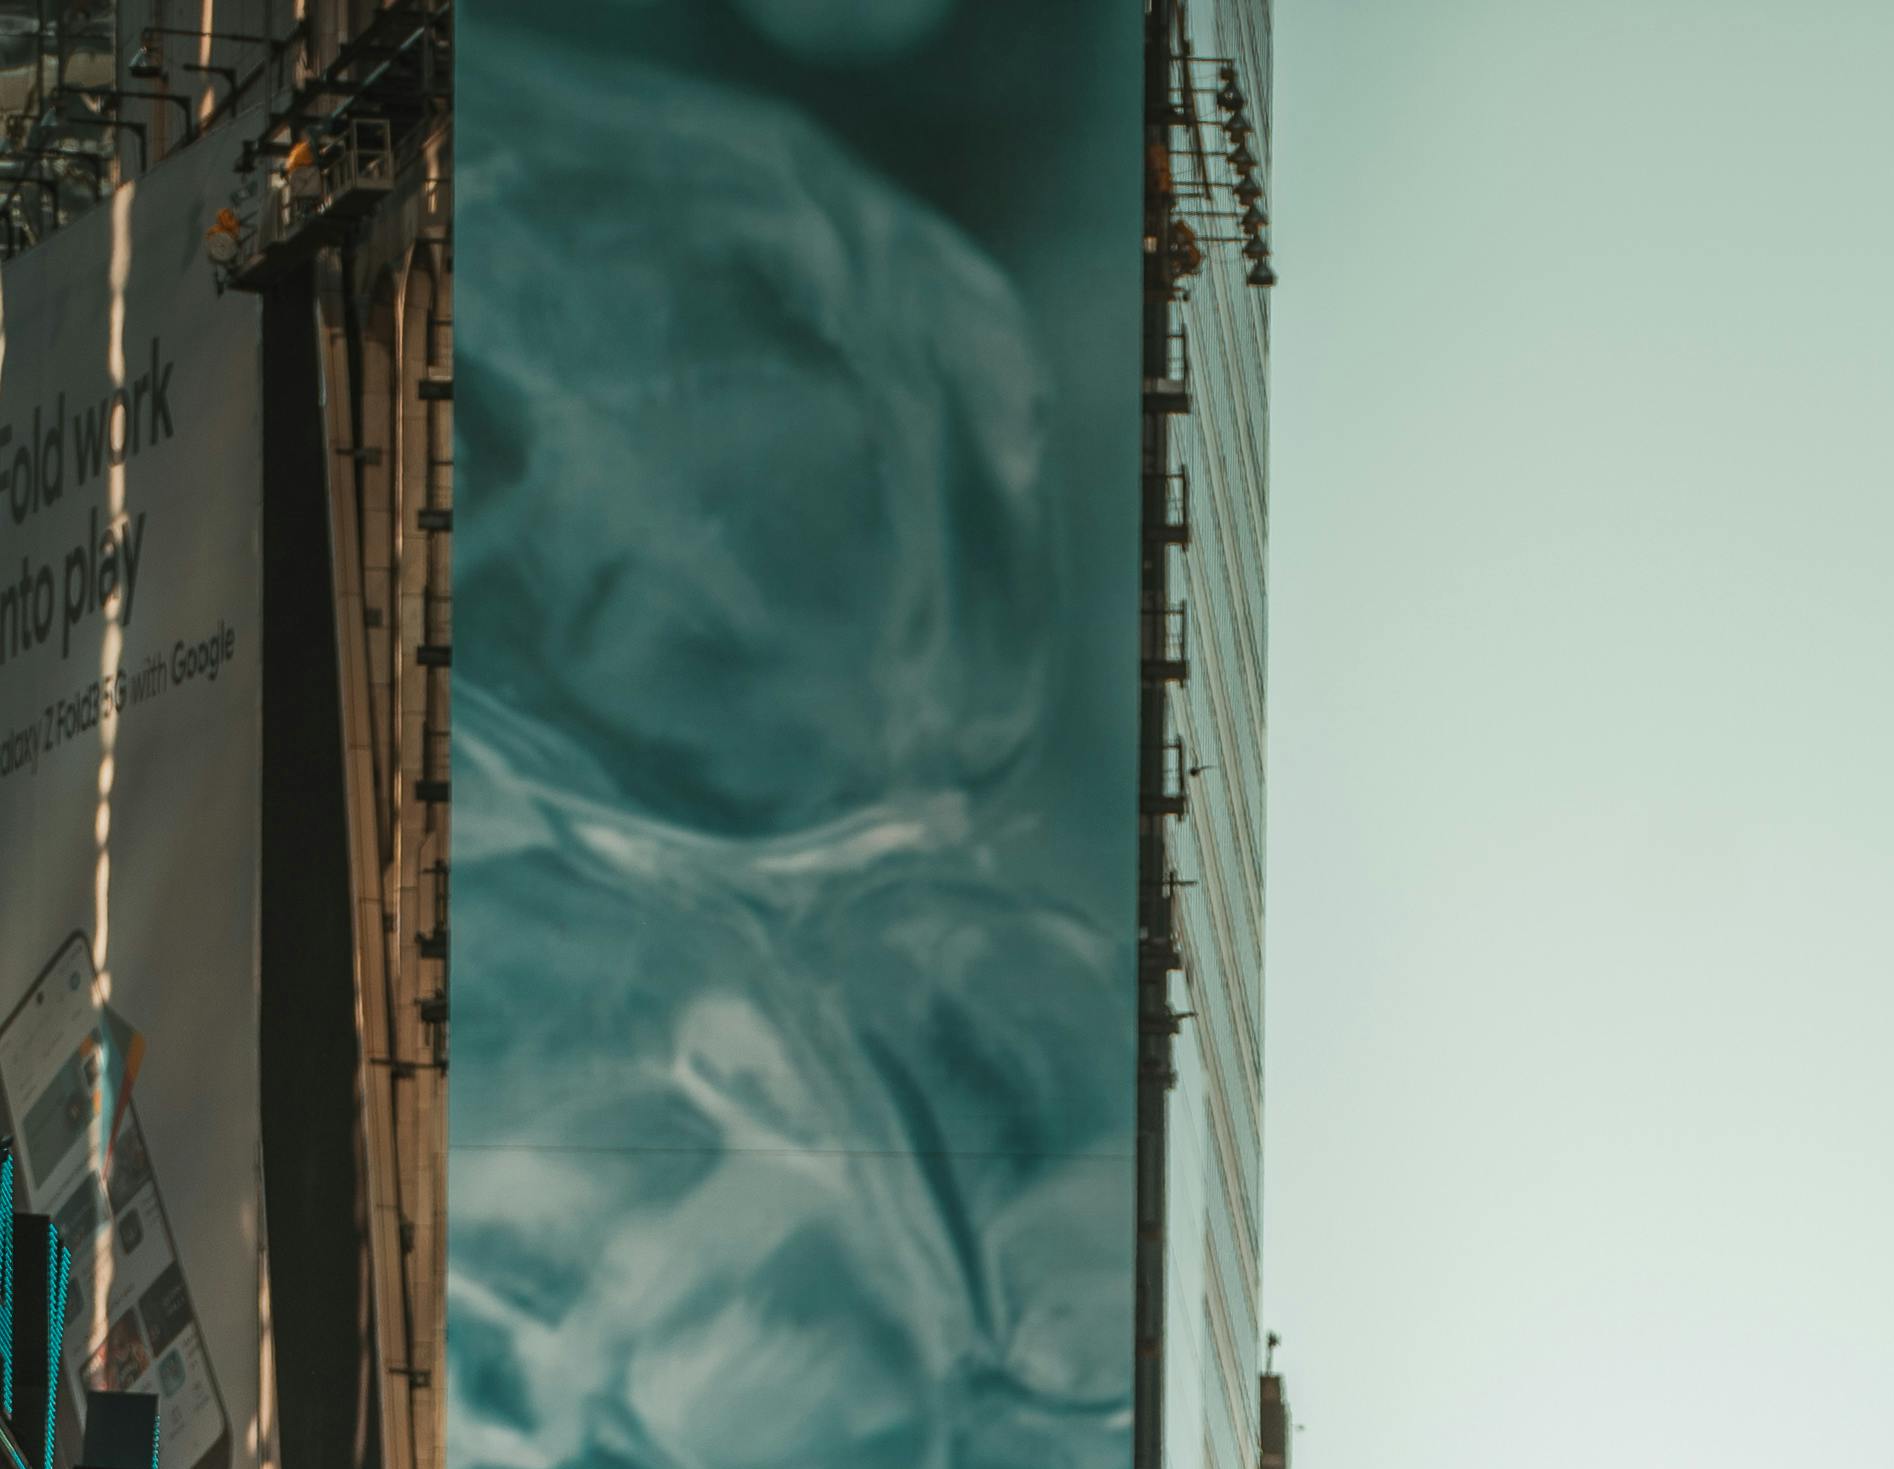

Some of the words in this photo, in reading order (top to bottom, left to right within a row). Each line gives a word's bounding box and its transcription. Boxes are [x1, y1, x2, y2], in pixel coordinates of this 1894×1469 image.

[73, 336, 174, 487] work
[62, 506, 146, 660] play
[170, 619, 236, 686] Google
